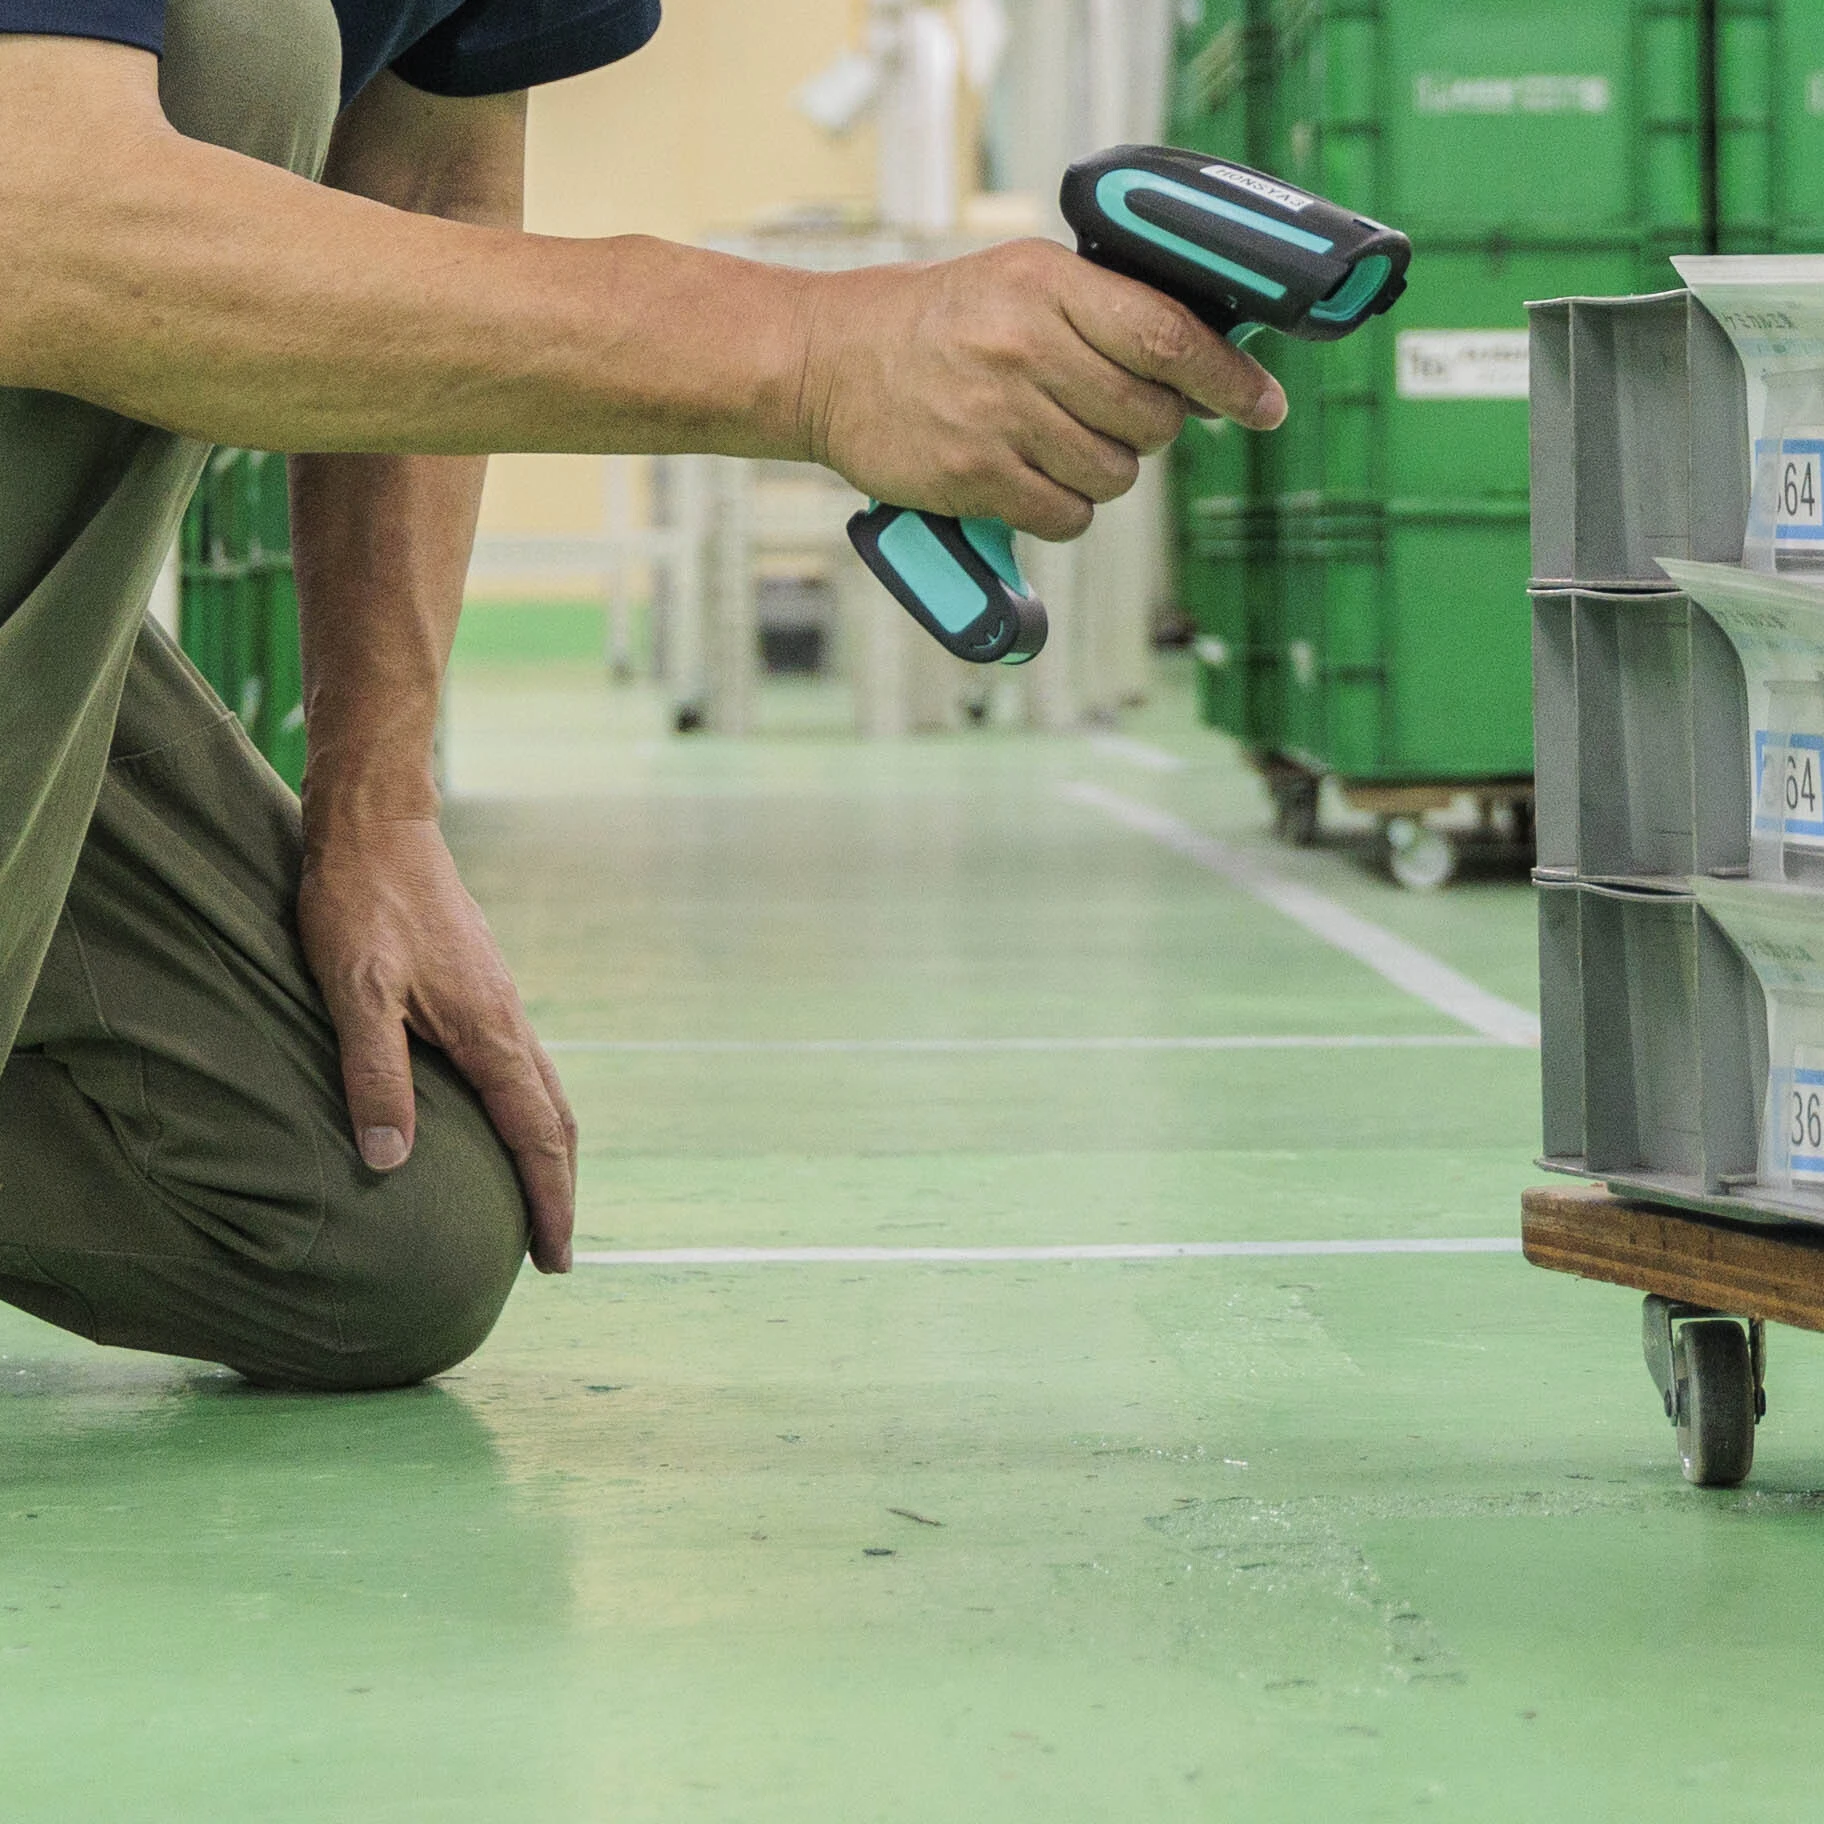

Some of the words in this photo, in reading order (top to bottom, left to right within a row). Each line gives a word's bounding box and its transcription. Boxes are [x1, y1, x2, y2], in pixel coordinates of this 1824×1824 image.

[1215, 167, 1305, 207] HONSYA3
[1768, 462, 1816, 517] 64
[1770, 755, 1816, 813] 64
